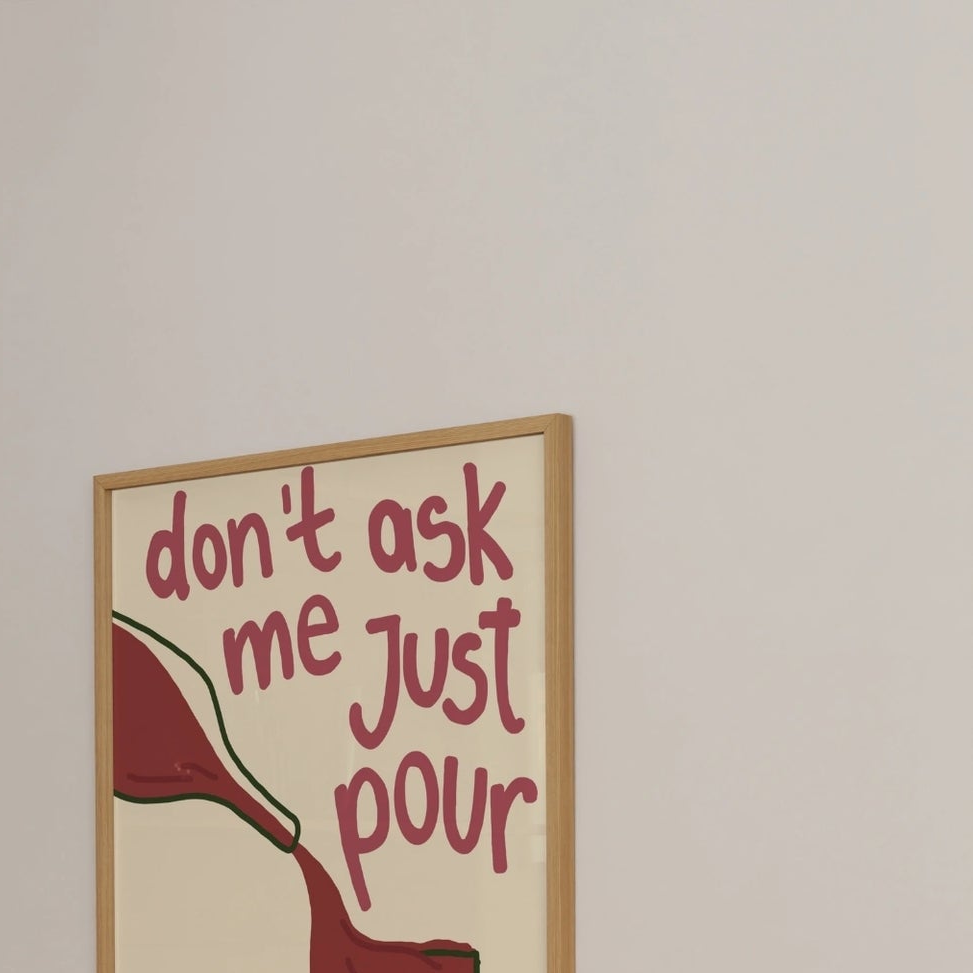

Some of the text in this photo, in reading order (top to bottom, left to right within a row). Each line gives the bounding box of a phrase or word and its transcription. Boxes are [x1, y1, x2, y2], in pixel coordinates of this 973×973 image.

[145, 462, 514, 602] don't ask
[222, 594, 342, 695] me
[334, 751, 539, 912] pour
